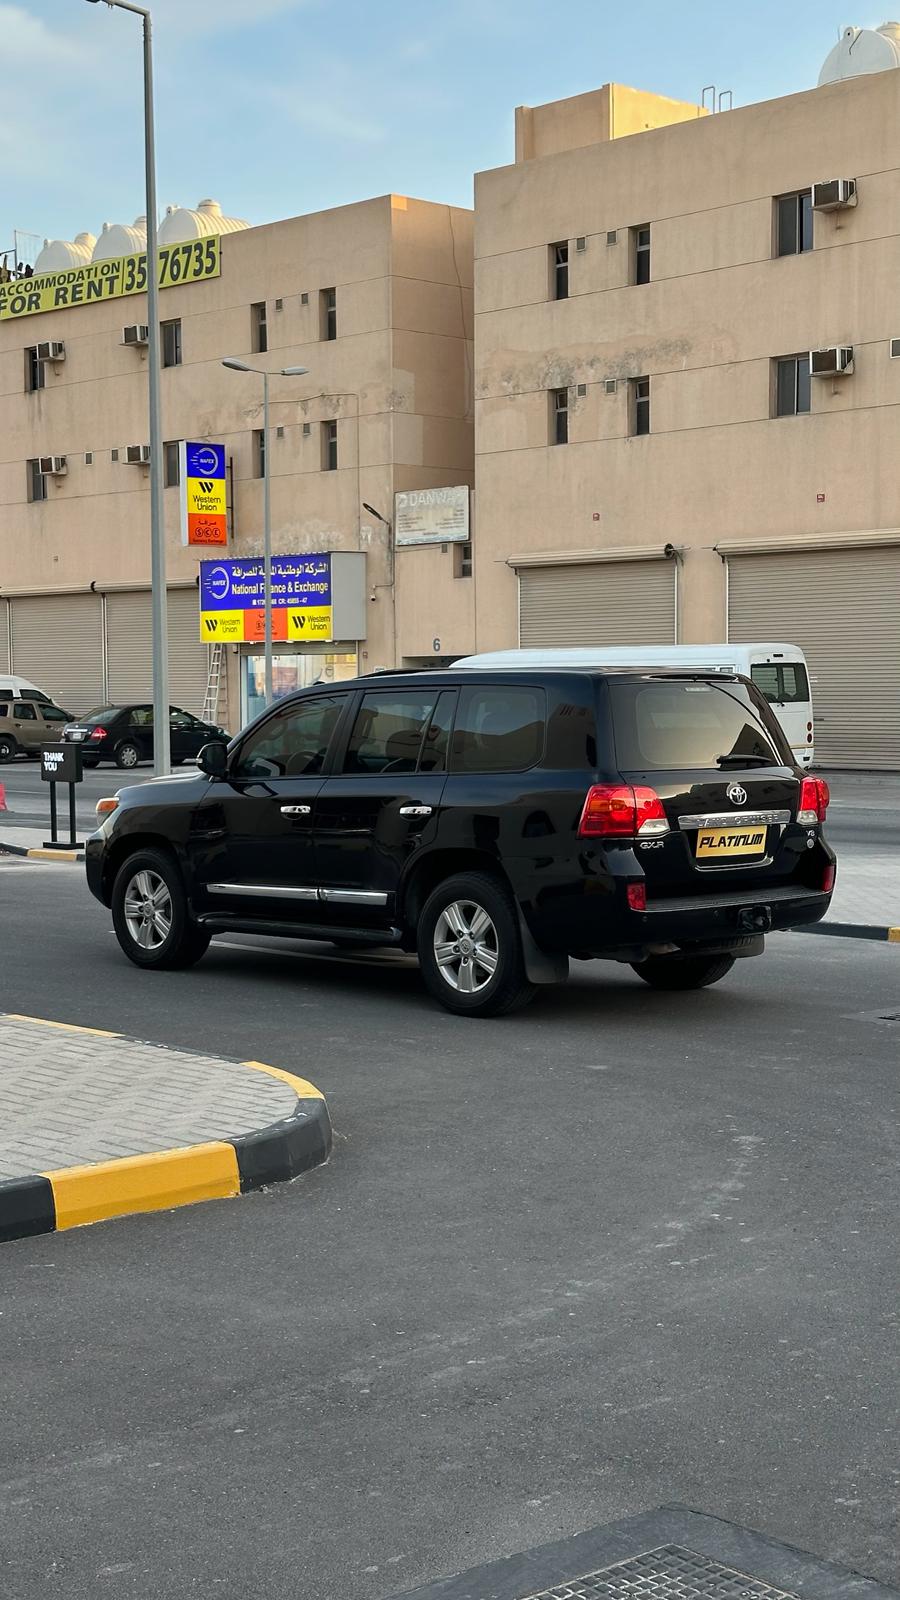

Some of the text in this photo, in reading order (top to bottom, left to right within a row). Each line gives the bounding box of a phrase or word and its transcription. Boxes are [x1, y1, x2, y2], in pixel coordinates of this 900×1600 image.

[125, 239, 216, 291] 3576735
[0, 261, 121, 297] ACCOMMODATION
[0, 275, 119, 314] FOR RENT
[193, 495, 221, 503] Western
[197, 502, 217, 511] Union
[305, 562, 329, 576] الشركة
[231, 581, 328, 594] National Fance & Exchange
[307, 615, 330, 623] Western
[310, 623, 327, 631] Union
[433, 638, 440, 651] 6
[43, 752, 65, 762] THANK
[44, 761, 58, 771] YOU
[640, 841, 665, 850] GXR
[699, 833, 764, 849] PLATINUM
